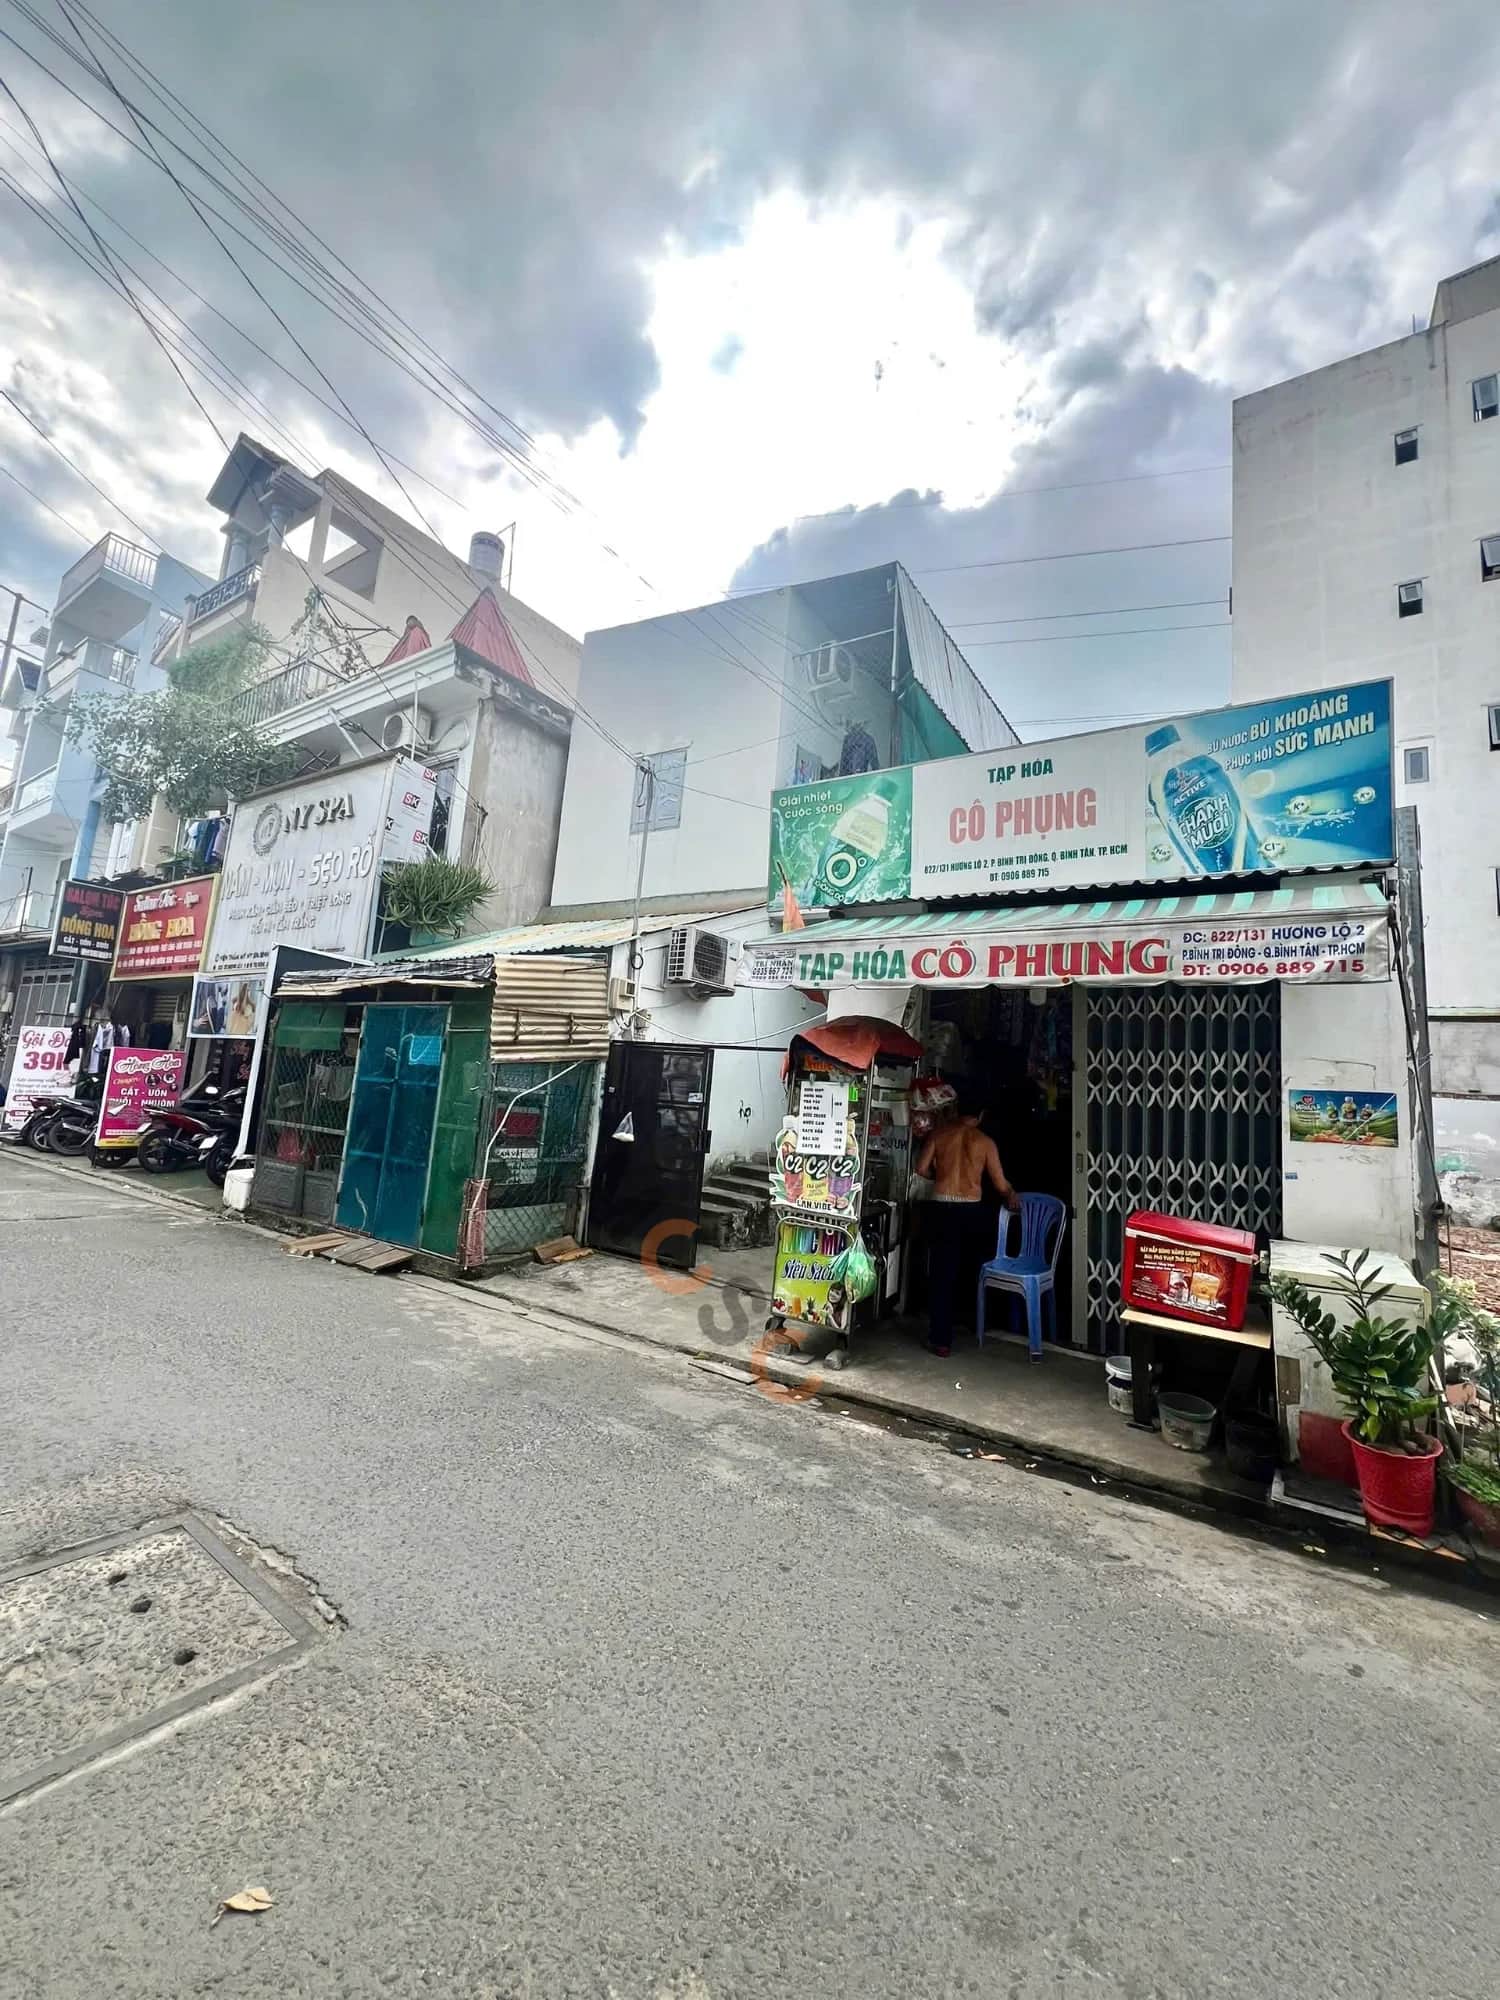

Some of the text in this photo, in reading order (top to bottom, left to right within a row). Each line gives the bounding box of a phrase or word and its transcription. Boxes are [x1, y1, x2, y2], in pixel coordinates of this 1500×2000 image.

[1250, 715, 1270, 741] BÙ
[1274, 694, 1349, 732] KHOÁNG
[1225, 753, 1252, 771] PHỤC
[1274, 732, 1309, 757] SỨC
[1313, 712, 1375, 746] MẠNH
[424, 767, 438, 782] SK
[987, 758, 1053, 785] TẠP HÓA
[403, 792, 420, 808] SK
[803, 790, 831, 804] nhiệt
[1173, 776, 1208, 806] ACTIVE
[315, 793, 354, 825] SPA
[785, 806, 812, 819] cuộc
[949, 788, 1097, 844] CÔ PHỤNG
[1179, 791, 1230, 837] CHANH
[413, 830, 428, 845] SK
[924, 861, 949, 874] 822/131
[997, 855, 1014, 867] BÌNH
[1060, 849, 1078, 861] BÌNH
[1110, 844, 1128, 856] HCM
[261, 858, 295, 896] MỤN
[309, 850, 344, 888] SẸO
[1001, 870, 1020, 881] 0906
[1021, 869, 1036, 879] 889
[1037, 867, 1050, 878] 715
[93, 921, 114, 940] HOA
[165, 916, 195, 939] HOA
[1183, 922, 1365, 944] ĐC: 822/131 HƯƠNG LỘ 2
[799, 938, 1173, 987] TẠP HÓA CÔ PHỤNG
[1182, 946, 1209, 961] P.BÌNH
[1212, 948, 1224, 962] TRỊ
[1263, 945, 1297, 958] Q.BÌNH
[1300, 943, 1319, 957] TÂN
[1328, 942, 1365, 956] TP.HCM
[1182, 959, 1365, 976] ĐT: 0906 889 715
[785, 1155, 803, 1174] C2
[806, 1156, 828, 1180] C2
[831, 1155, 853, 1177] C2
